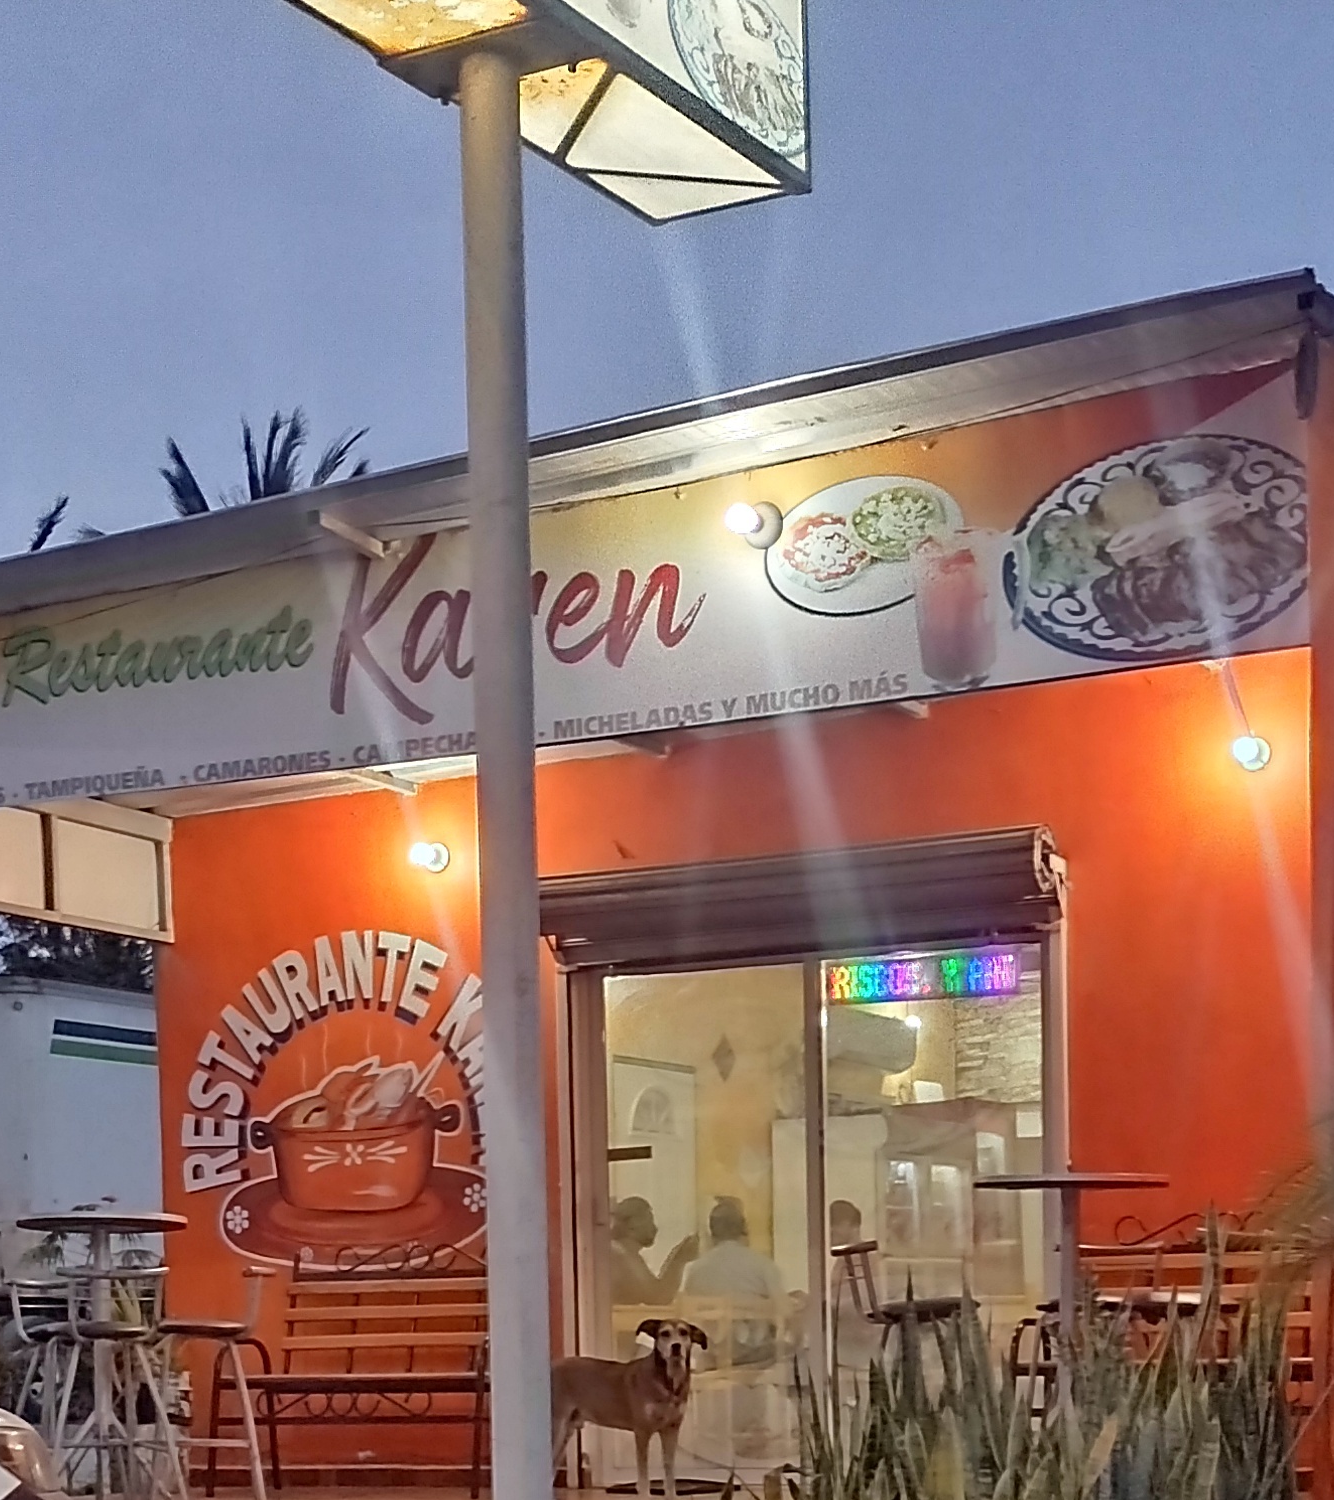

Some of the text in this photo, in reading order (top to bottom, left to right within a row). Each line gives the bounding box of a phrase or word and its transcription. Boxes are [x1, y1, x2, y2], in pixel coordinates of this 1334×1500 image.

[1, 604, 315, 708] Restaurante
[24, 765, 166, 801] TAMPIQUEÑA
[192, 749, 332, 783] CAMARONES
[553, 699, 713, 740] MICHELADAS
[719, 697, 739, 719] Y
[745, 682, 841, 714] MUCHO
[848, 669, 909, 700] MÁS
[181, 929, 449, 1194] RESTAURANTE
